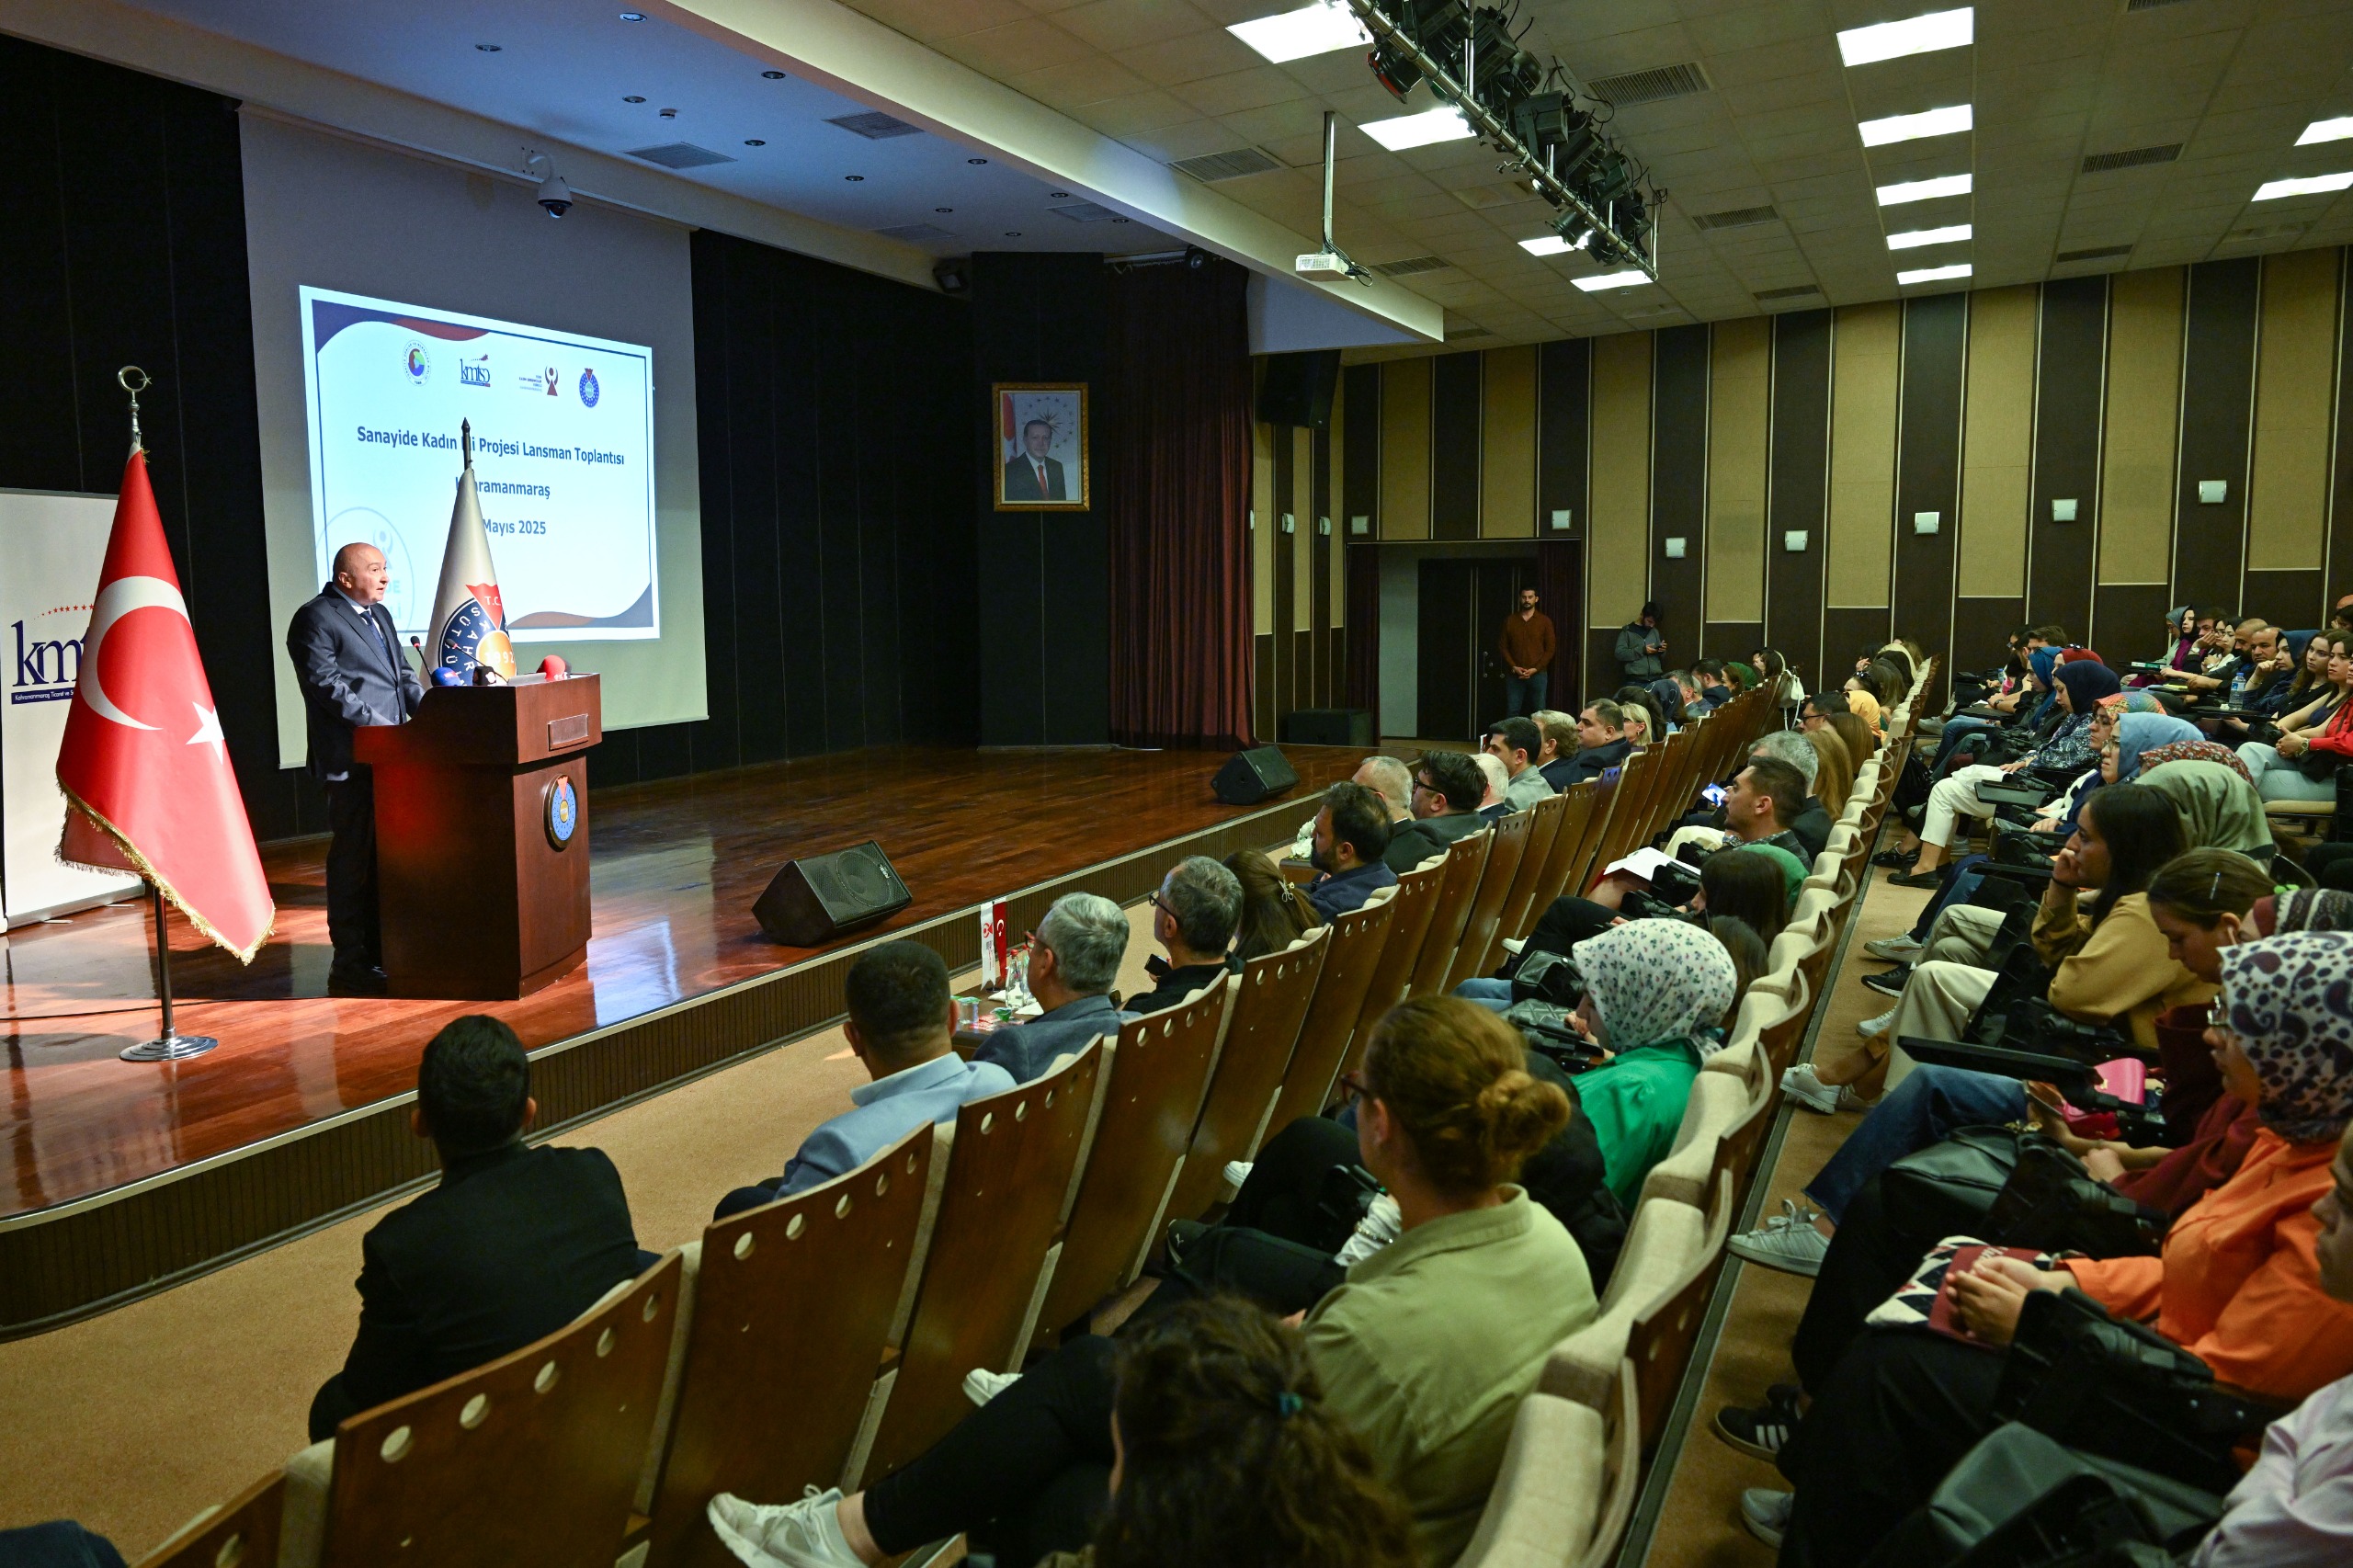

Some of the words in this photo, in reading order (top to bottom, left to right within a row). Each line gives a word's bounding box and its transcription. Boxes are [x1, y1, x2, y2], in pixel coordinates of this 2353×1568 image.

[357, 426, 418, 449] Sanayide
[422, 432, 458, 450] Kadın
[479, 437, 519, 458] Projesi
[522, 442, 572, 460] Lansman
[574, 447, 625, 466] Toplantısı
[455, 476, 551, 500] ramanmaraş
[483, 518, 516, 537] Mayıs
[518, 520, 547, 535] 2025
[11, 619, 90, 687] km
